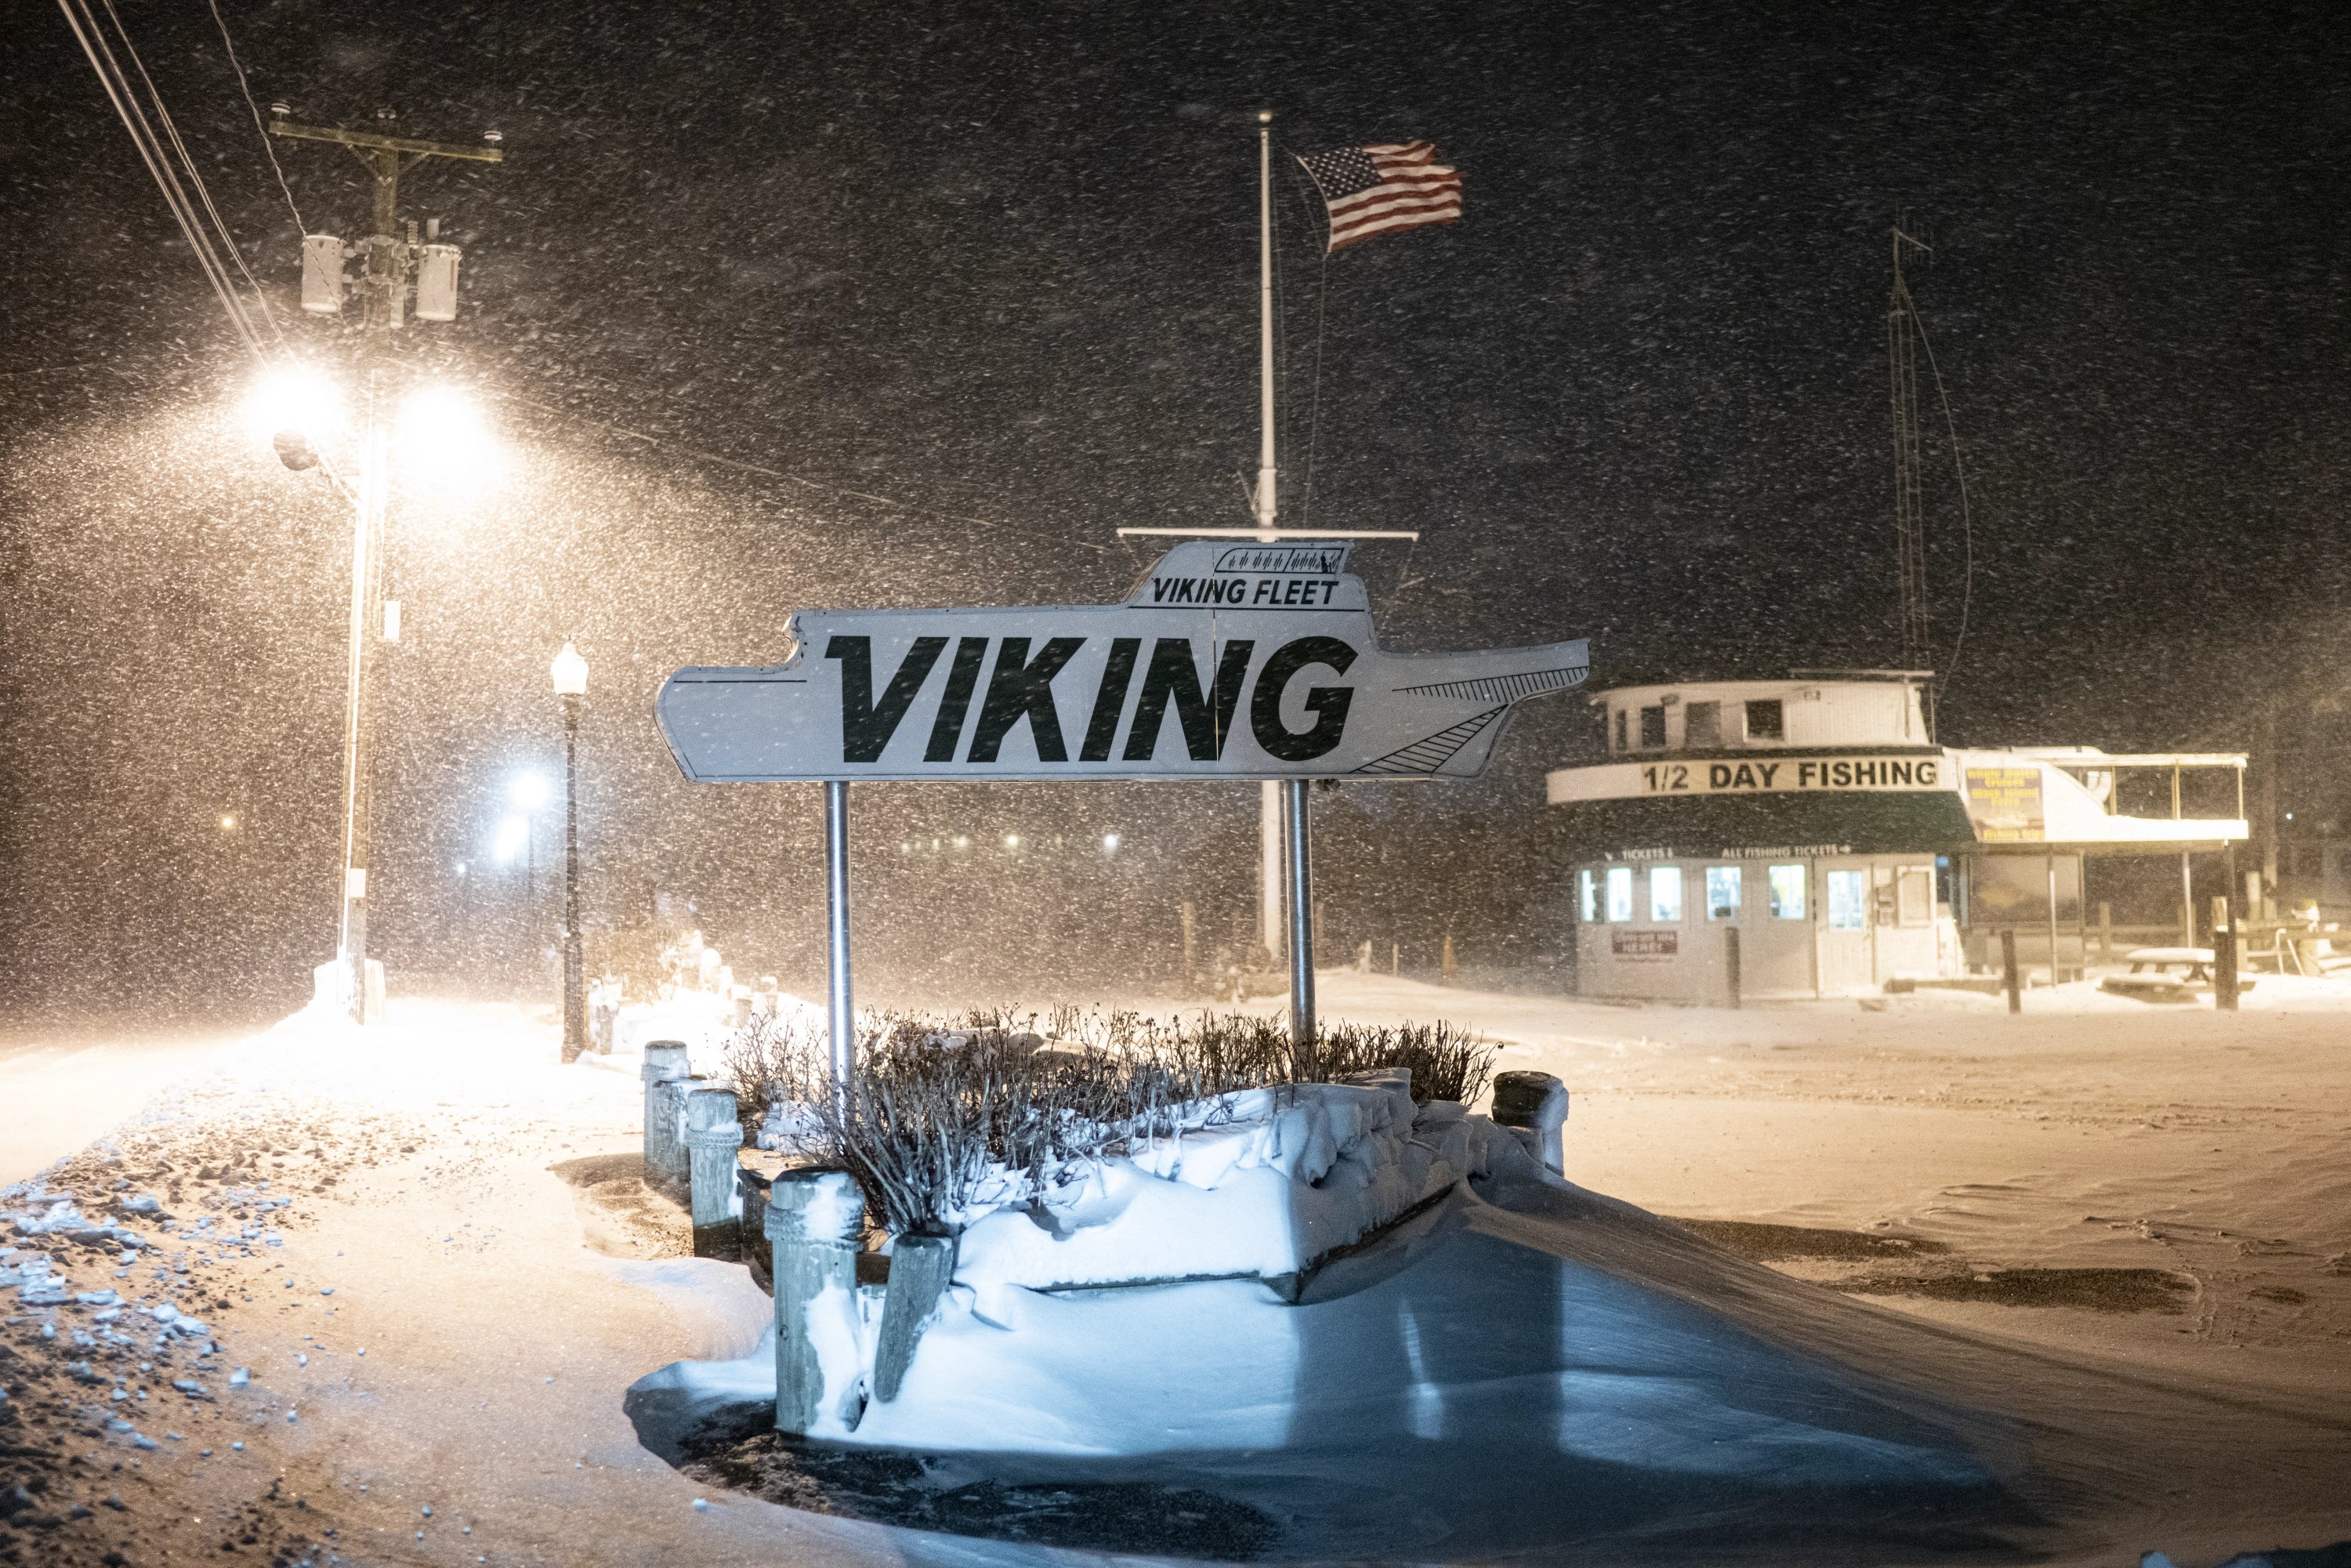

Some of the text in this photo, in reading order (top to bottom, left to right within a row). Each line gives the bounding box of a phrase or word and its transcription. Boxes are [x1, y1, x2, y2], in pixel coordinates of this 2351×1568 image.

[1153, 578, 1339, 605] VIKING FLEET
[824, 636, 1359, 763] VIKING
[1643, 762, 1937, 791] 1/2 DAY FISHING
[1622, 849, 1665, 860] TICKETS
[1722, 844, 1838, 858] ALL FISHING TICKETS
